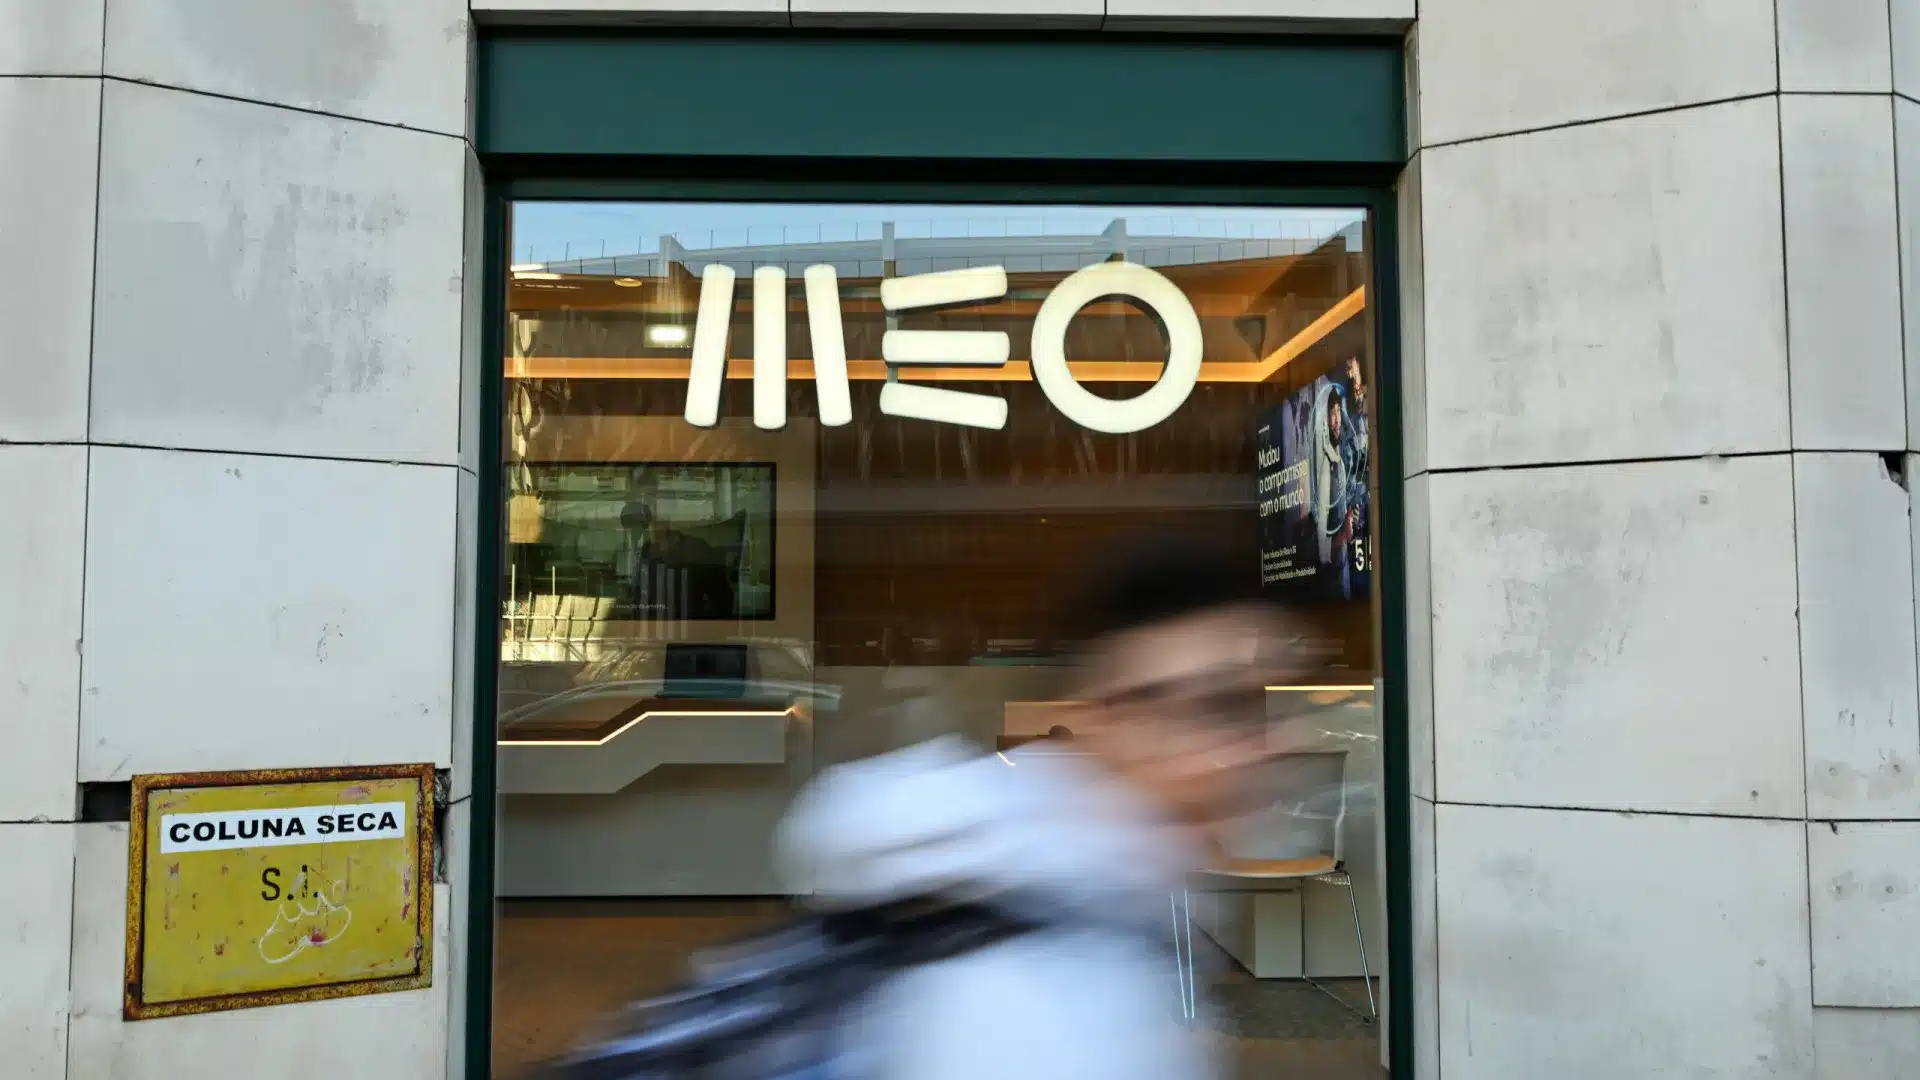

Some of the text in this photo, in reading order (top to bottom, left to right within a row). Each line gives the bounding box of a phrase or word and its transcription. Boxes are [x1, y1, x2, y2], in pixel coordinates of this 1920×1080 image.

[684, 261, 1203, 434] MEO
[1258, 446, 1280, 470] Mudou
[1259, 480, 1264, 494] o
[1260, 482, 1304, 517] com o mundo
[169, 811, 398, 843] COLUNA SECA
